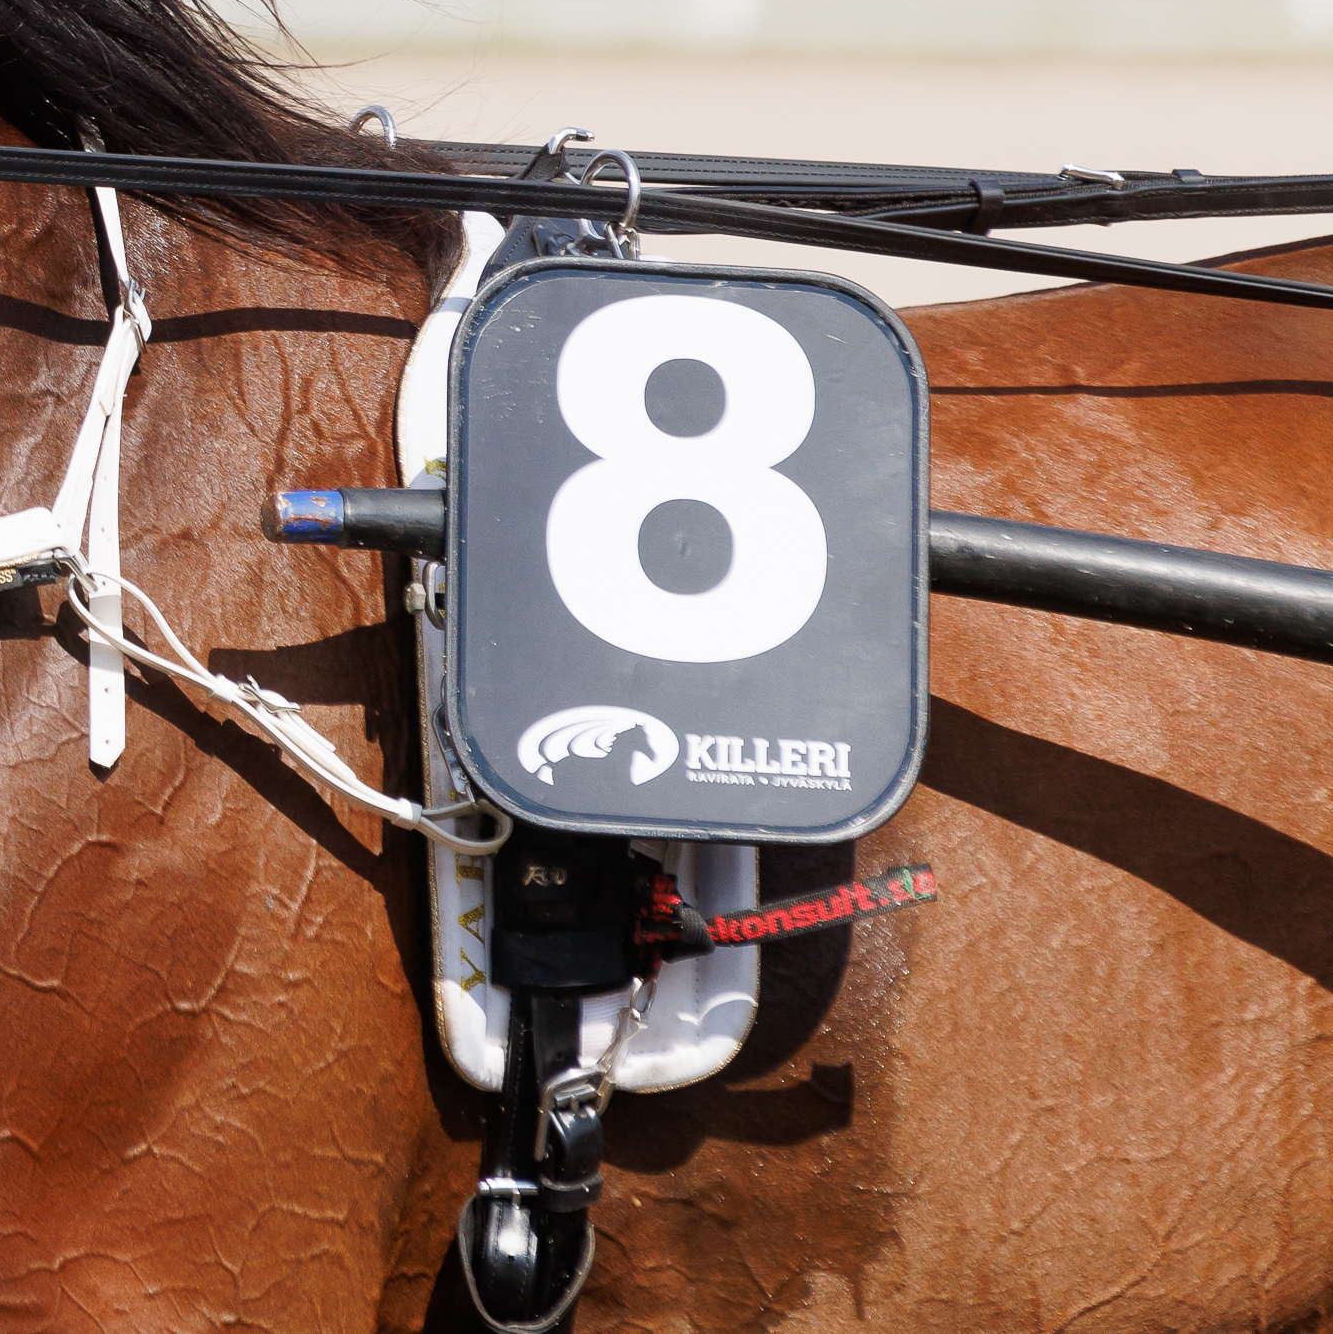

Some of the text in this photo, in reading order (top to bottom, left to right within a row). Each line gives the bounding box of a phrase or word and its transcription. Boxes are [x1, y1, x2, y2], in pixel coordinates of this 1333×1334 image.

[546, 295, 828, 664] 8
[685, 733, 852, 778] KILLERI
[686, 770, 853, 792] RAVIRATA JYVÄSKYLÄ
[707, 872, 938, 943] konsult.se
